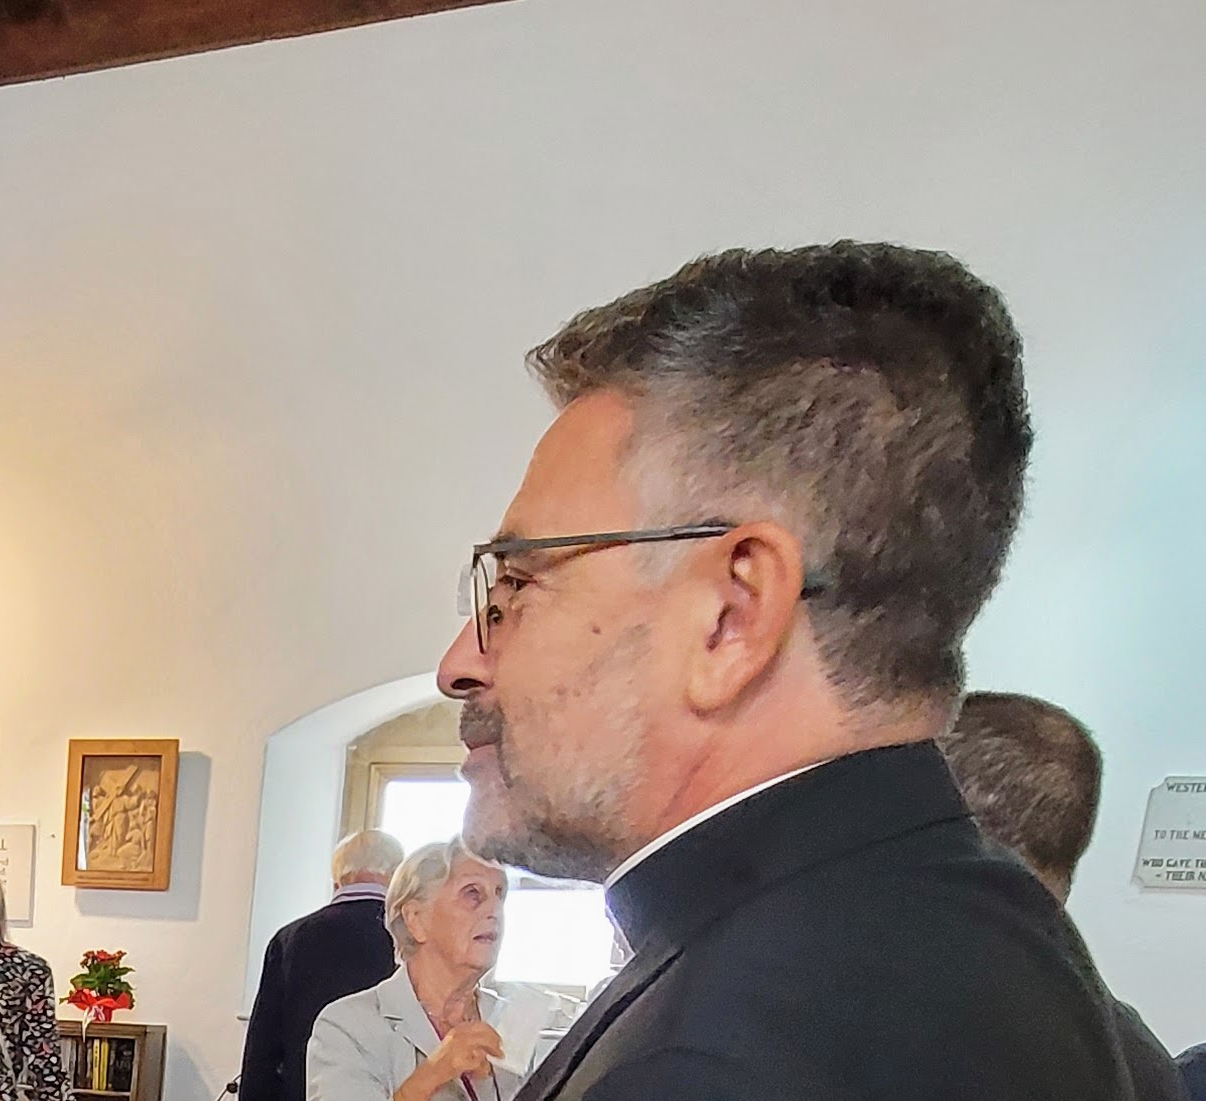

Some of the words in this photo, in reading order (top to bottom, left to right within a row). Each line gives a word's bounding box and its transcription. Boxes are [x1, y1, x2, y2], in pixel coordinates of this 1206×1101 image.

[1154, 829, 1167, 840] TO
[1170, 829, 1190, 840] THE
[1166, 858, 1192, 868] GAVE
[1166, 870, 1196, 881] THEIR
